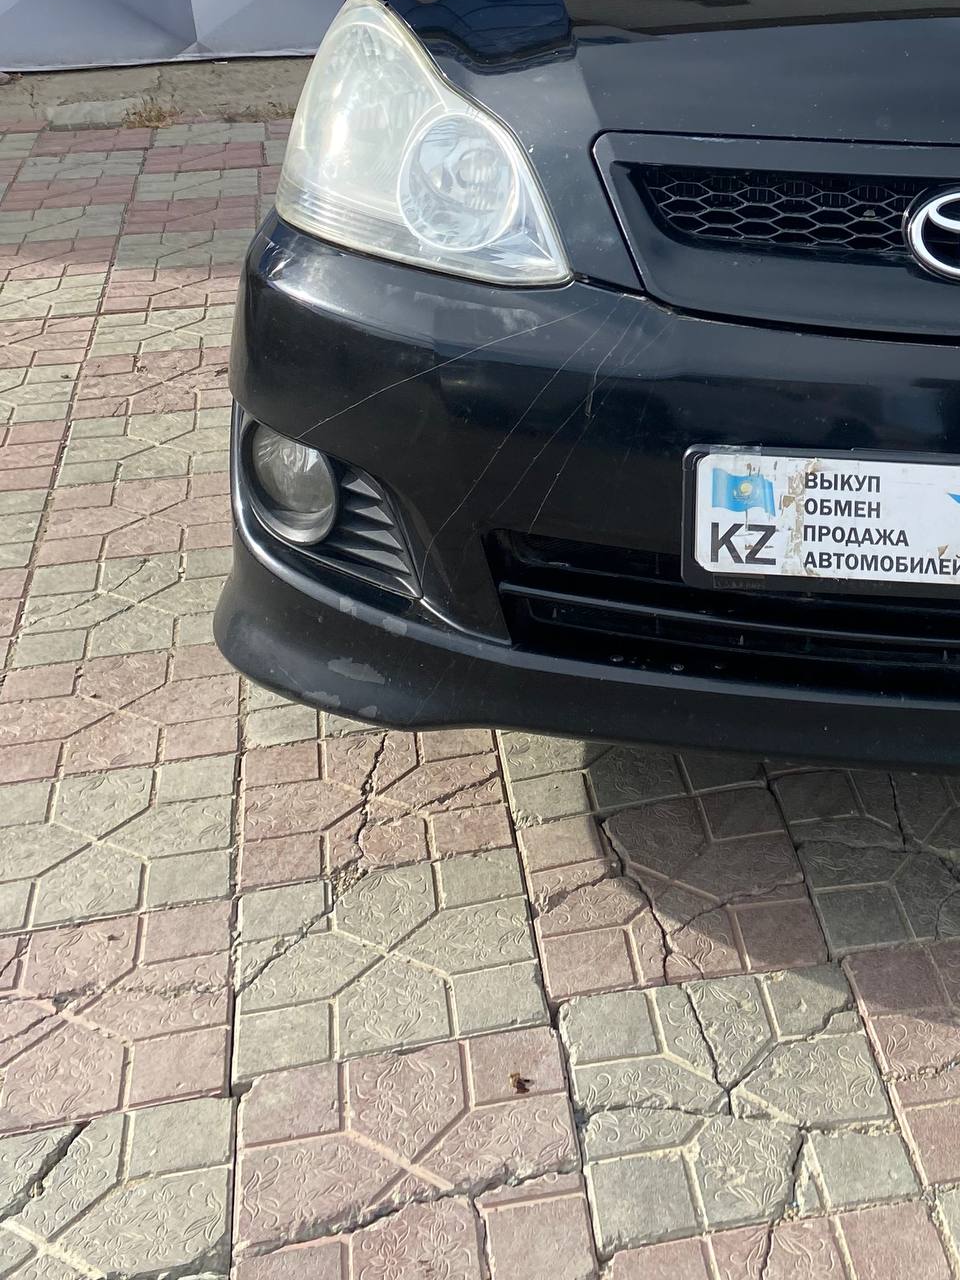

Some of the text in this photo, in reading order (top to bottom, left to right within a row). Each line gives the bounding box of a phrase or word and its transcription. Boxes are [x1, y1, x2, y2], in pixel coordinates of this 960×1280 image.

[804, 472, 881, 493] ВЫКУП
[804, 497, 881, 519] ОБМЕН
[710, 522, 777, 566] KZ
[803, 524, 909, 548] ПРОДАЖА
